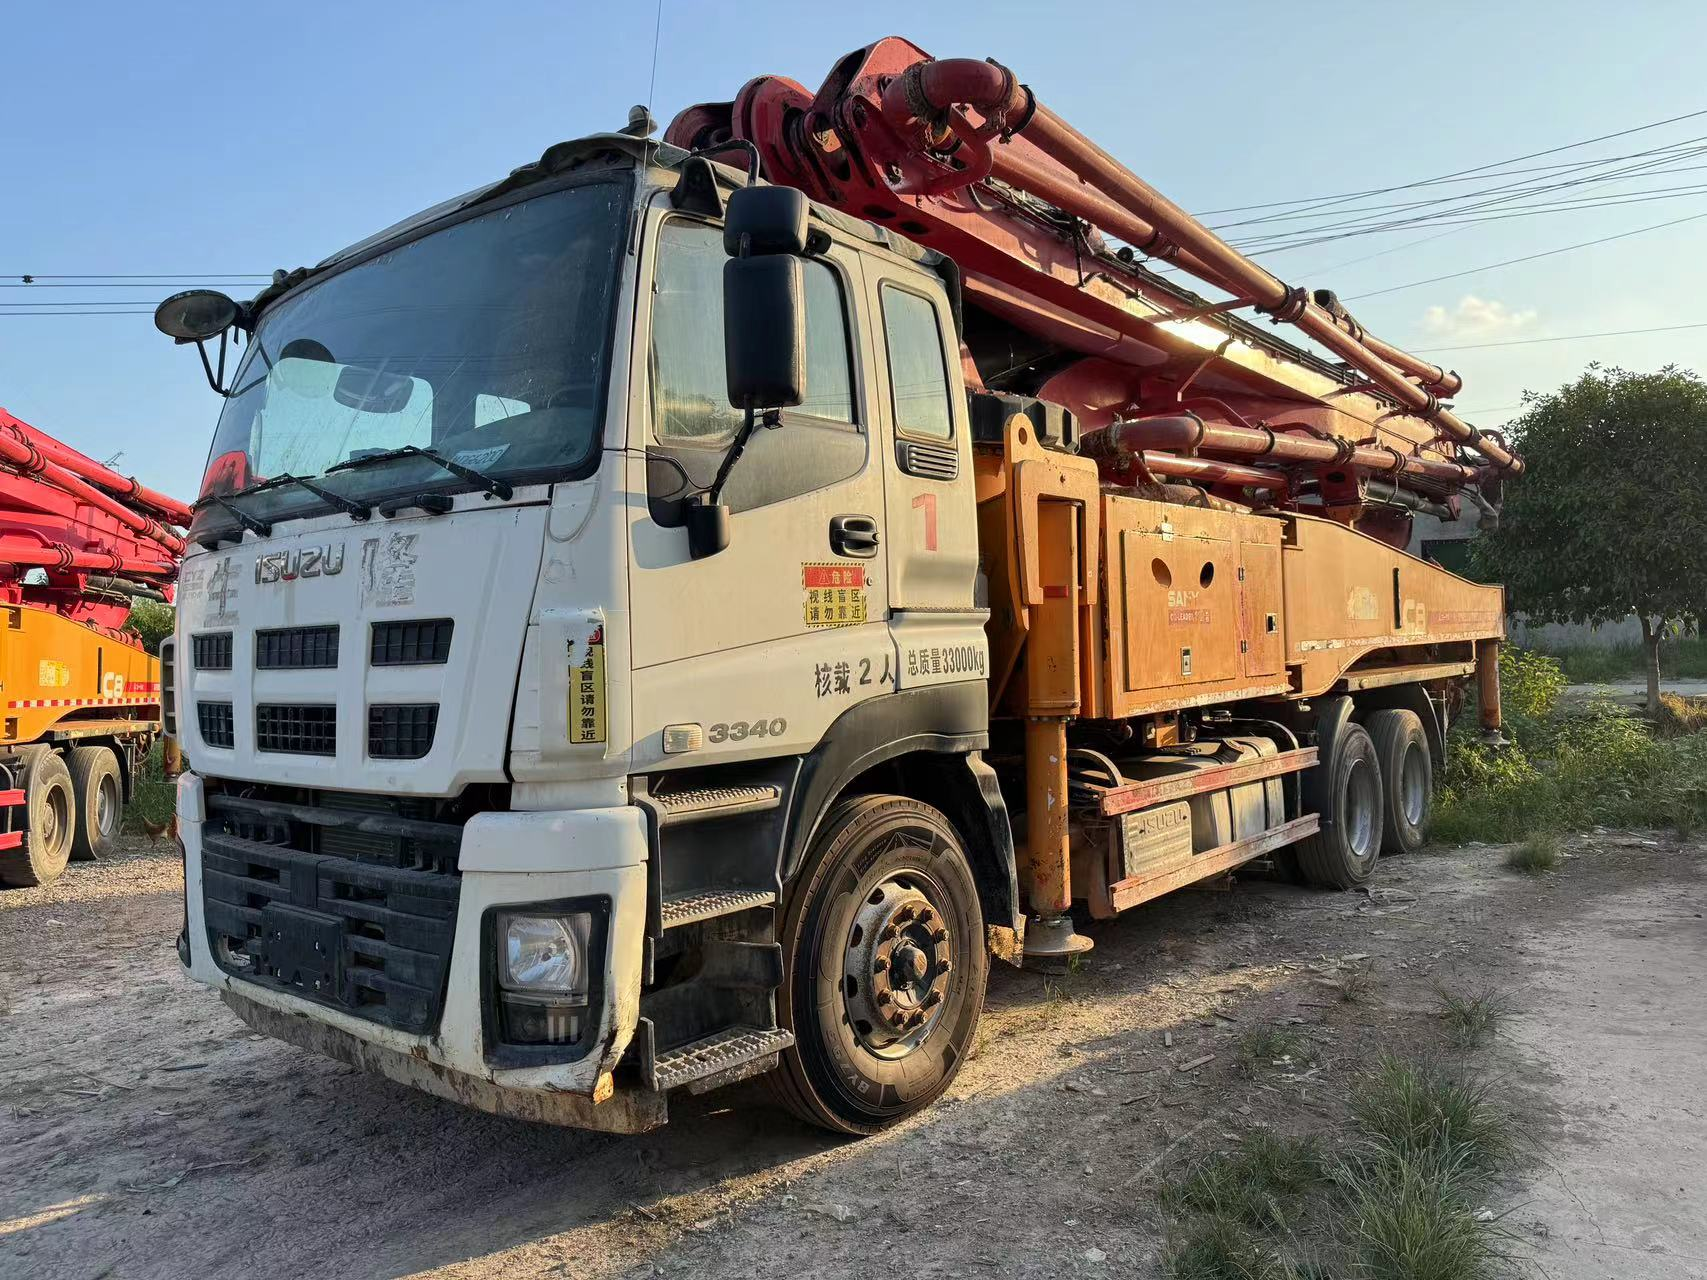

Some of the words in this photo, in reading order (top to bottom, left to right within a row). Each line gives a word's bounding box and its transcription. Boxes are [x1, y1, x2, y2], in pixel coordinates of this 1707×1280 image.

[911, 493, 937, 551] 1
[254, 542, 345, 584] ISUZU
[831, 570, 855, 585] 危险
[808, 588, 860, 604] 视线盲区
[809, 605, 861, 621] 请勿靠近
[907, 645, 986, 676] 总质量33000kg
[103, 671, 125, 699] C8
[708, 717, 788, 744] 3340
